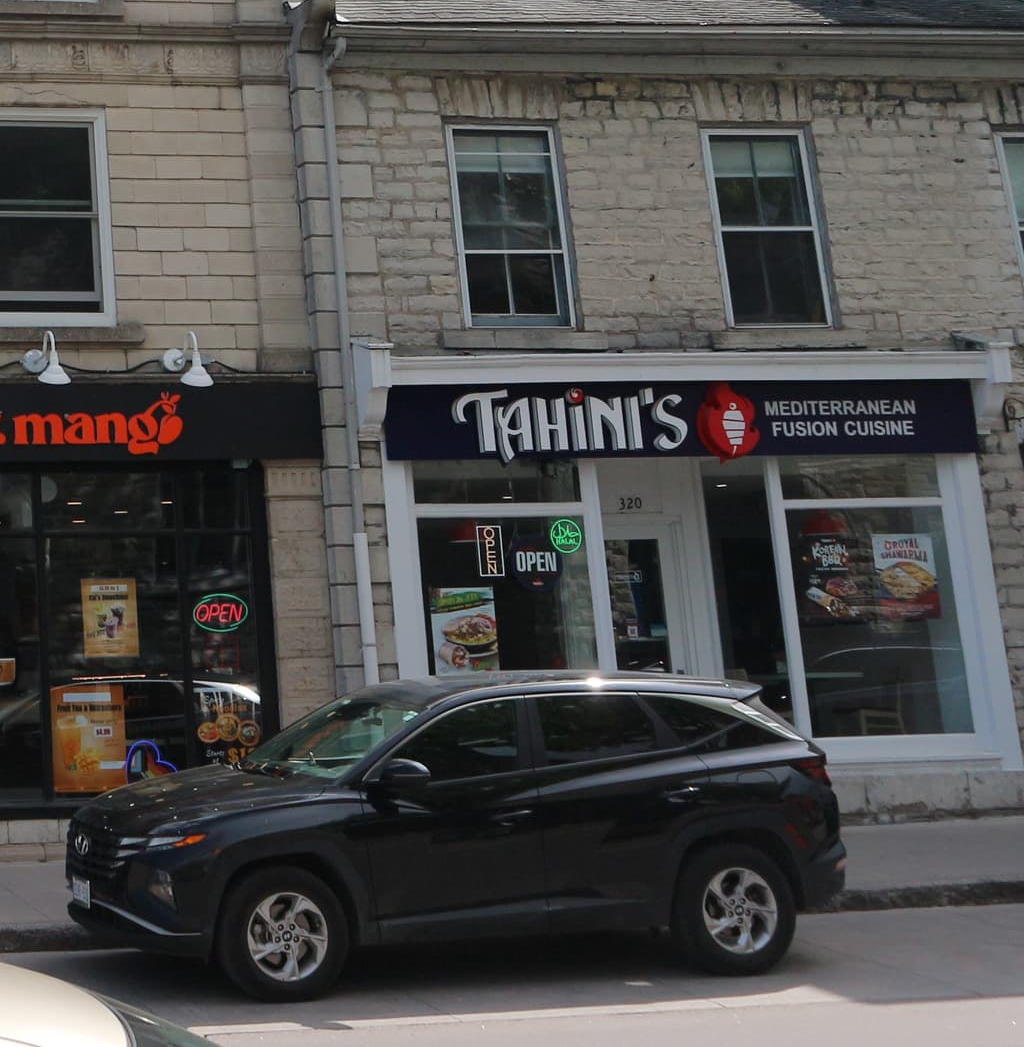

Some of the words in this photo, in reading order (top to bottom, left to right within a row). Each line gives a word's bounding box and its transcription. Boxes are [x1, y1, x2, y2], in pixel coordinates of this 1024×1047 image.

[764, 399, 917, 416] MEDITERRANEAN
[773, 420, 838, 437] FUSION
[844, 419, 914, 437] CUISINE
[619, 498, 642, 511] 320
[556, 535, 578, 546] HALAL
[483, 526, 498, 575] OPEN
[812, 544, 849, 560] KOREAN
[516, 550, 557, 572] OPEN
[822, 554, 843, 567] BBQ
[196, 604, 243, 623] OPEN
